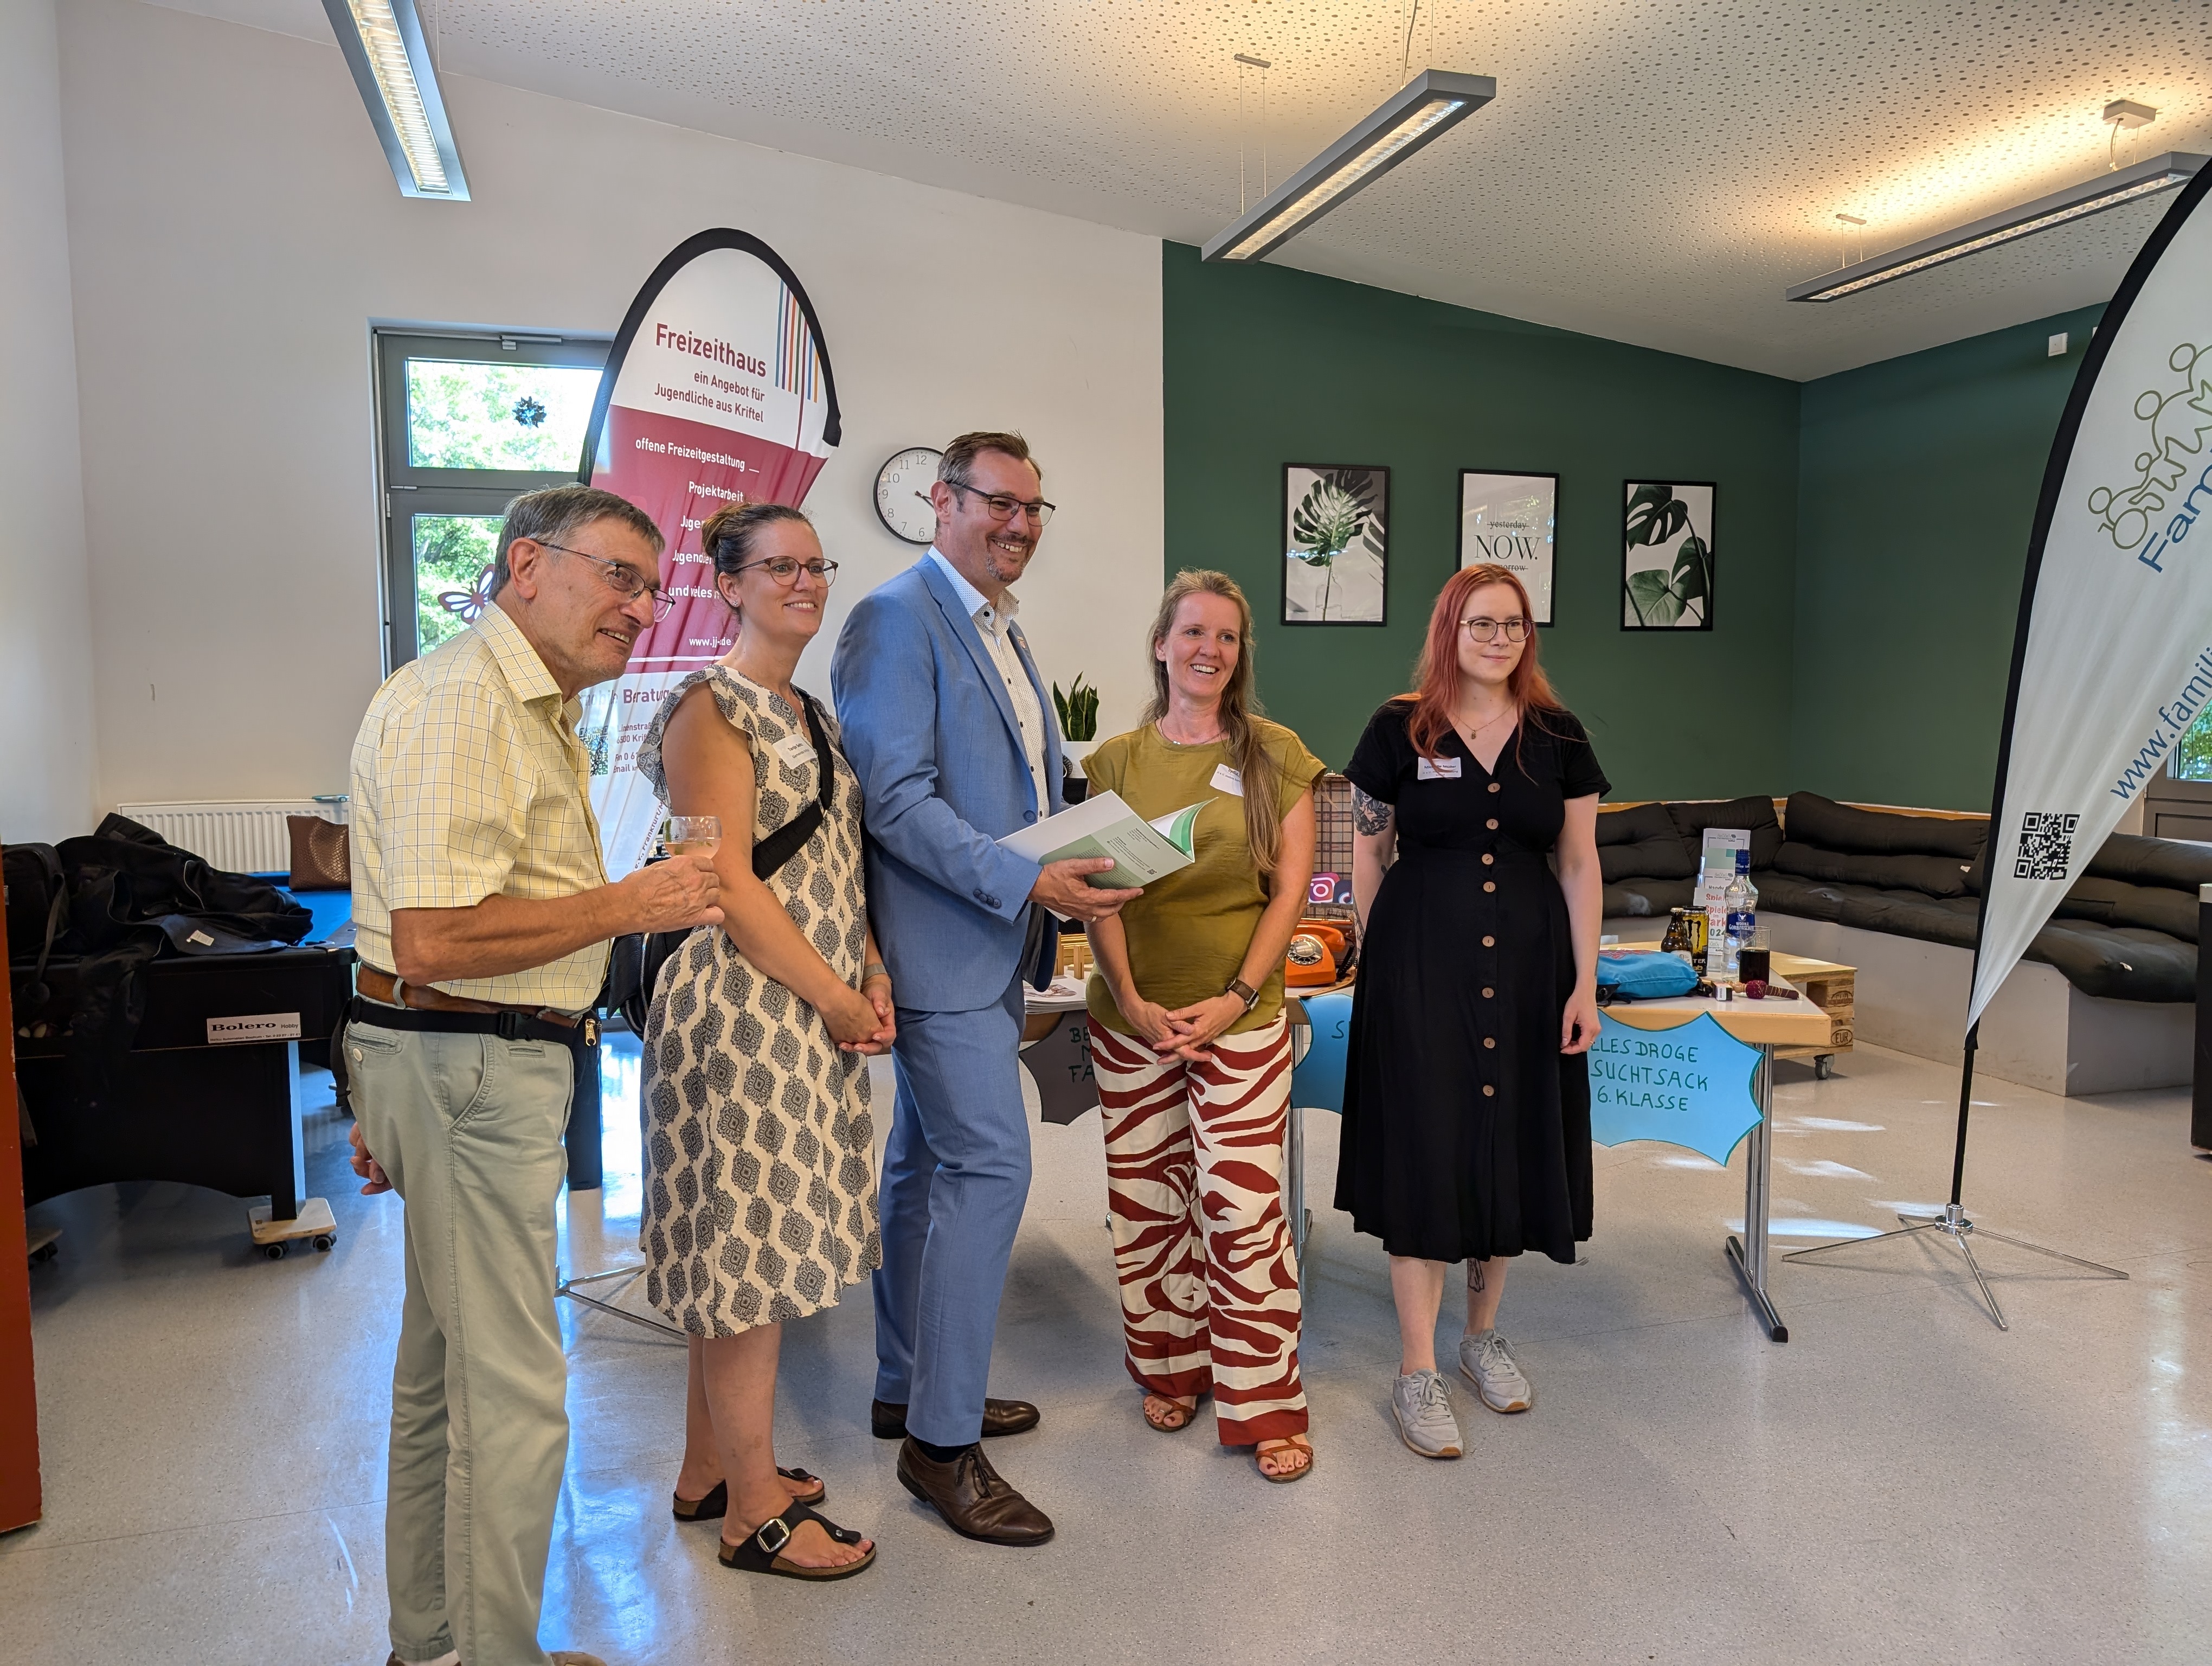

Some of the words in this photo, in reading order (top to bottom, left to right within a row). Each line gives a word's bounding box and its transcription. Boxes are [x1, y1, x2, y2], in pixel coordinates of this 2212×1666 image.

[656, 323, 766, 377] Freizeithaus
[694, 371, 708, 385] ein
[711, 374, 749, 398] Angebot
[751, 387, 765, 402] für
[654, 383, 713, 408] Jugendliche
[716, 400, 732, 413] aus
[735, 402, 764, 422] Kriftel
[635, 437, 666, 453] offene
[667, 442, 745, 472] Freizeitgestaltung
[915, 454, 927, 465] 12
[899, 459, 910, 470] 11
[886, 472, 901, 484] 10
[689, 480, 744, 503] Projektarbeit
[882, 490, 889, 499] 9
[887, 508, 895, 518] 8
[2138, 448, 2212, 573] Fam
[901, 521, 908, 531] 7
[918, 527, 925, 537] 6
[1489, 520, 1528, 531] yesterday
[1474, 534, 1541, 561] NOW.
[668, 585, 689, 597] und
[1708, 917, 1726, 927] ark
[211, 1022, 276, 1031] Bolero
[1069, 1027, 1090, 1043] BE
[1835, 1031, 1848, 1043] EUR
[1591, 1037, 1631, 1054] LLES
[1635, 1041, 1699, 1063] DROGE
[1068, 1064, 1096, 1083] FA
[1590, 1059, 1708, 1091] SUCHTSACK
[1597, 1085, 1612, 1103] 6.
[1616, 1088, 1689, 1111] KLASSE
